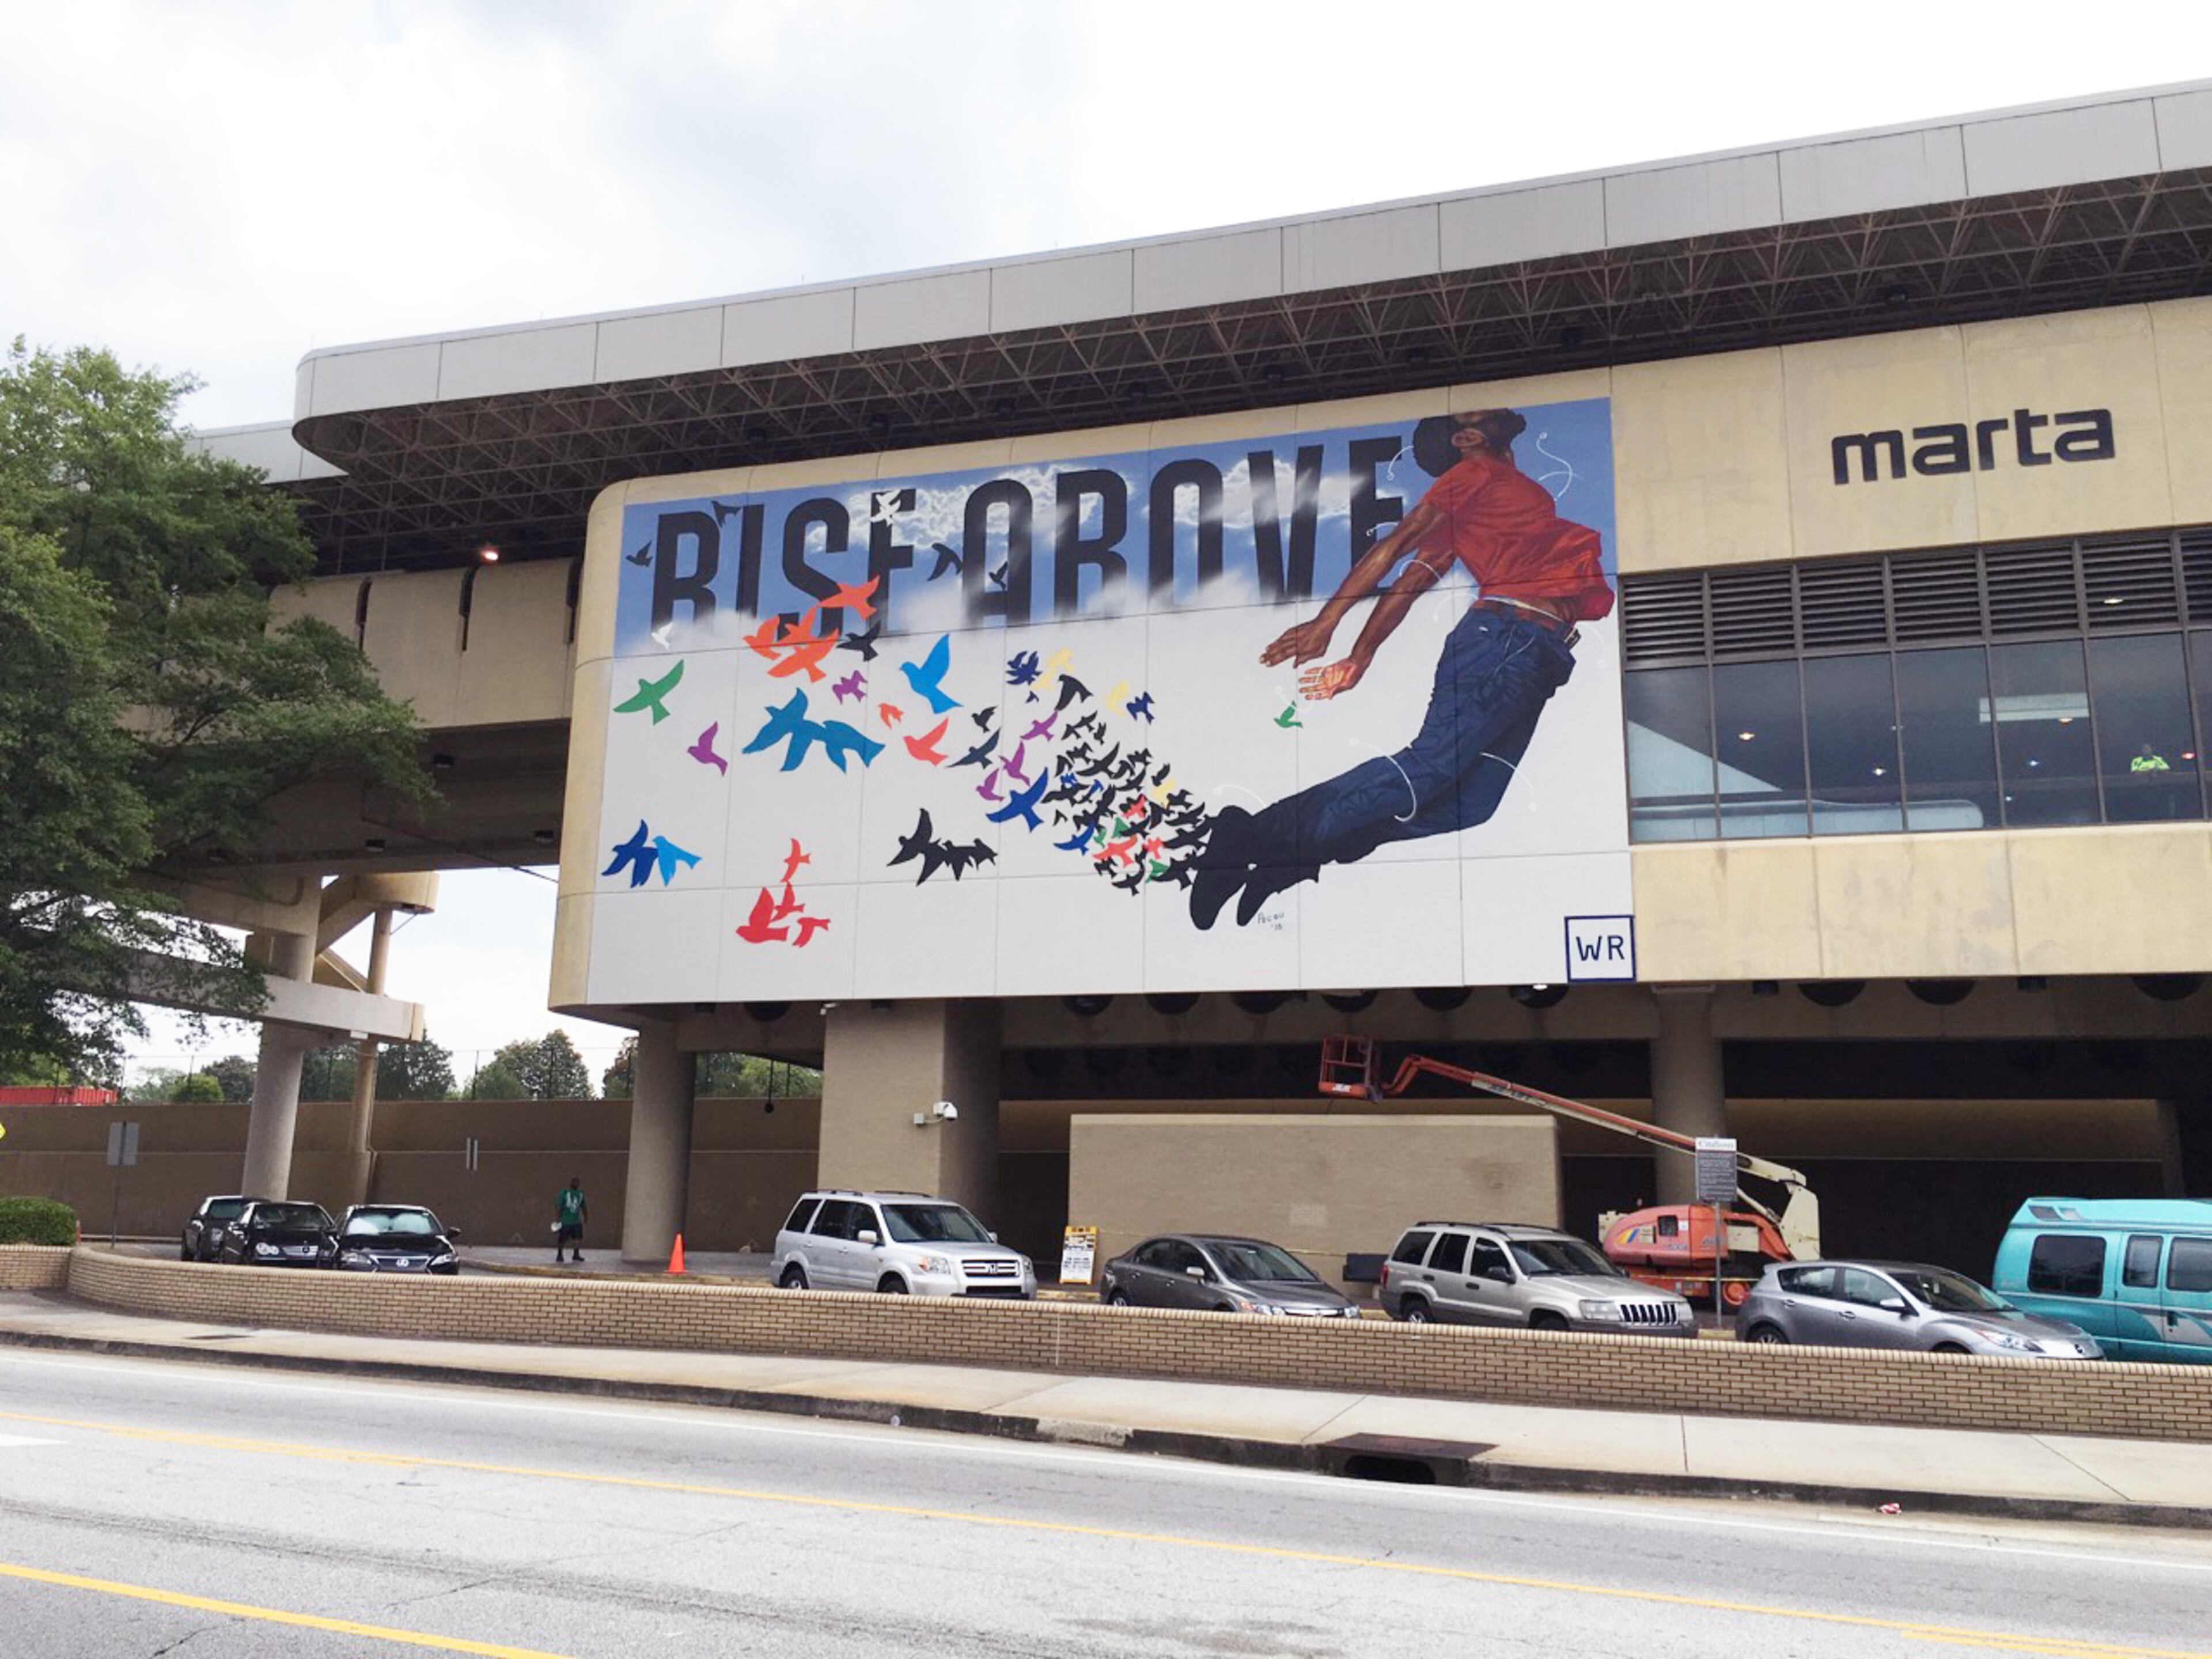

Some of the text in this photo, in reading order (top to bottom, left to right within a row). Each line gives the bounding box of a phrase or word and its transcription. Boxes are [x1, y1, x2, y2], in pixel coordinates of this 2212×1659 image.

[1832, 408, 2116, 485] marta
[652, 436, 1404, 637] RISE ABOVE
[1575, 935, 1625, 961] WR
